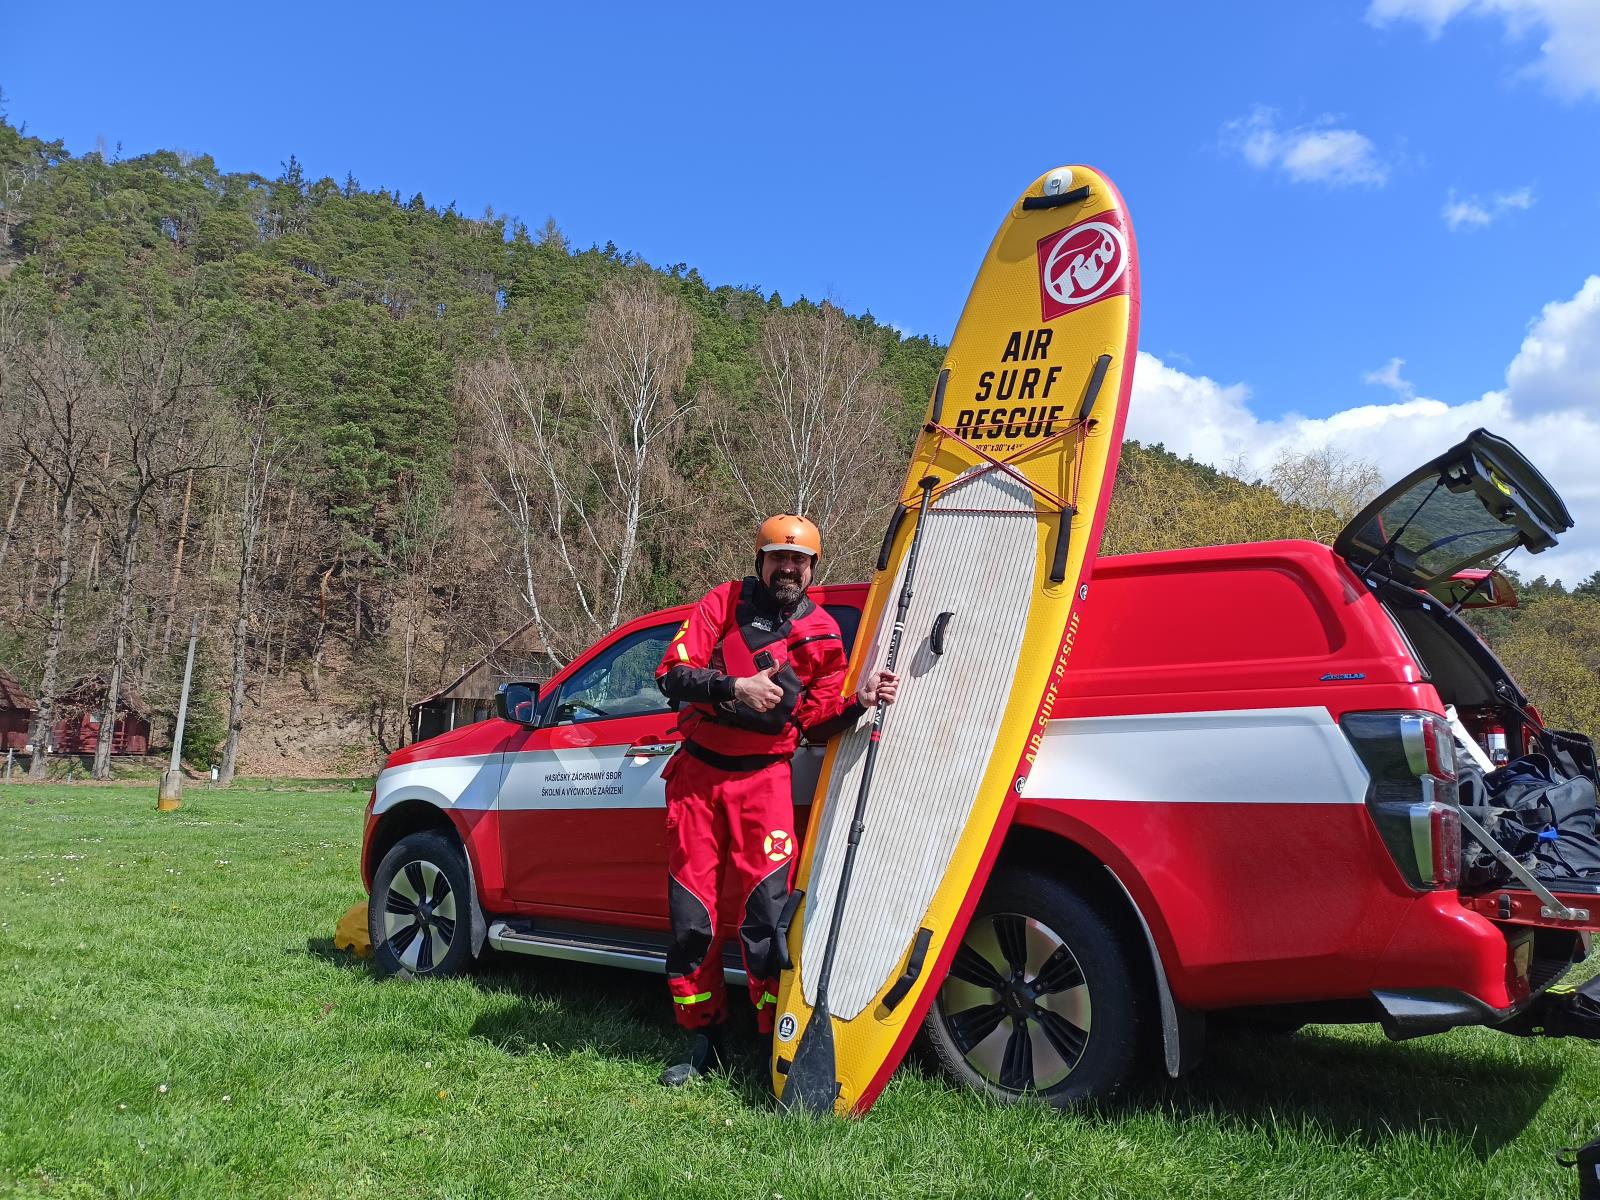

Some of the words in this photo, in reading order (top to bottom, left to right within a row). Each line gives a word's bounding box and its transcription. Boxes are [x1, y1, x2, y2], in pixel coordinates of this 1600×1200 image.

[1001, 328, 1053, 363] AIR
[975, 366, 1062, 402] SURF
[955, 406, 1064, 440] RESCUE
[542, 786, 561, 797] ŠKOLNÍ
[598, 784, 624, 796] ZAŘÍZENÍ
[545, 771, 571, 782] HASIČSKÝ
[571, 771, 605, 781] ZÁCHRANNÝ
[606, 771, 622, 781] SBOR
